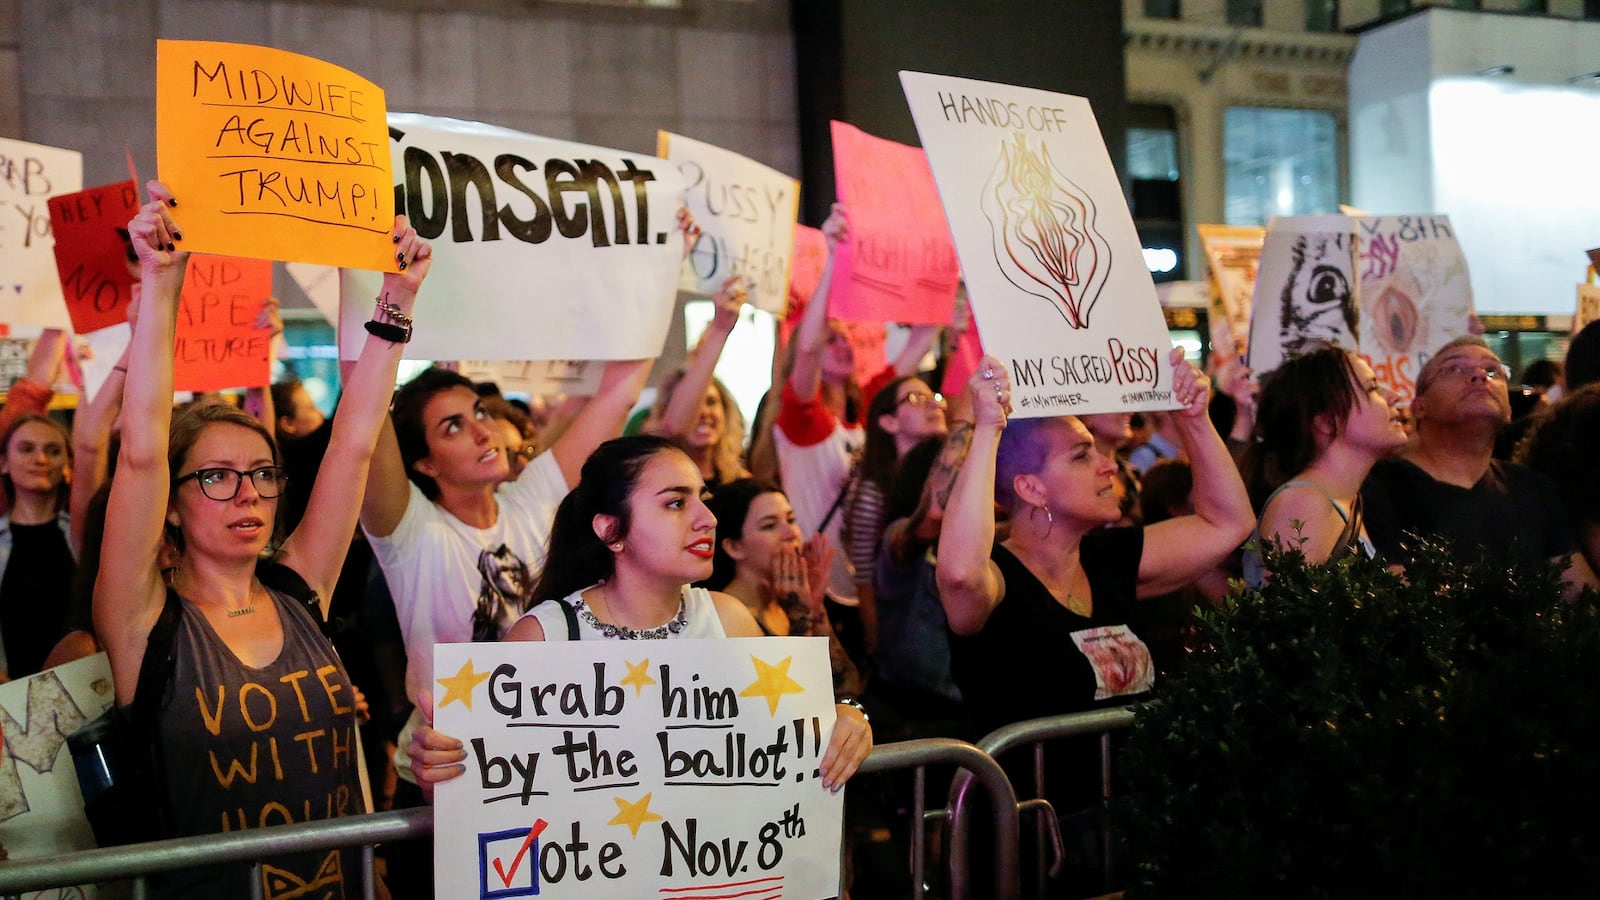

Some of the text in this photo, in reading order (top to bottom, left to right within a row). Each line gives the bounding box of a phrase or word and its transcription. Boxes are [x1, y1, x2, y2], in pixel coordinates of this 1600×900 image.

[193, 60, 365, 119] MIDWIFE
[938, 92, 1068, 134] HANDS OFF
[216, 115, 380, 167] AGAINST
[59, 192, 104, 223] HEY
[220, 168, 379, 222] TRUMP!
[64, 262, 119, 313] NO
[1011, 358, 1045, 388] MY
[1051, 355, 1112, 386] SACRED
[196, 664, 352, 736] VOTE
[488, 662, 740, 721] Grab him
[208, 726, 351, 790] WITH
[470, 716, 822, 806] by the ballot!!
[659, 818, 749, 878] Nov.
[757, 802, 806, 871] 8th
